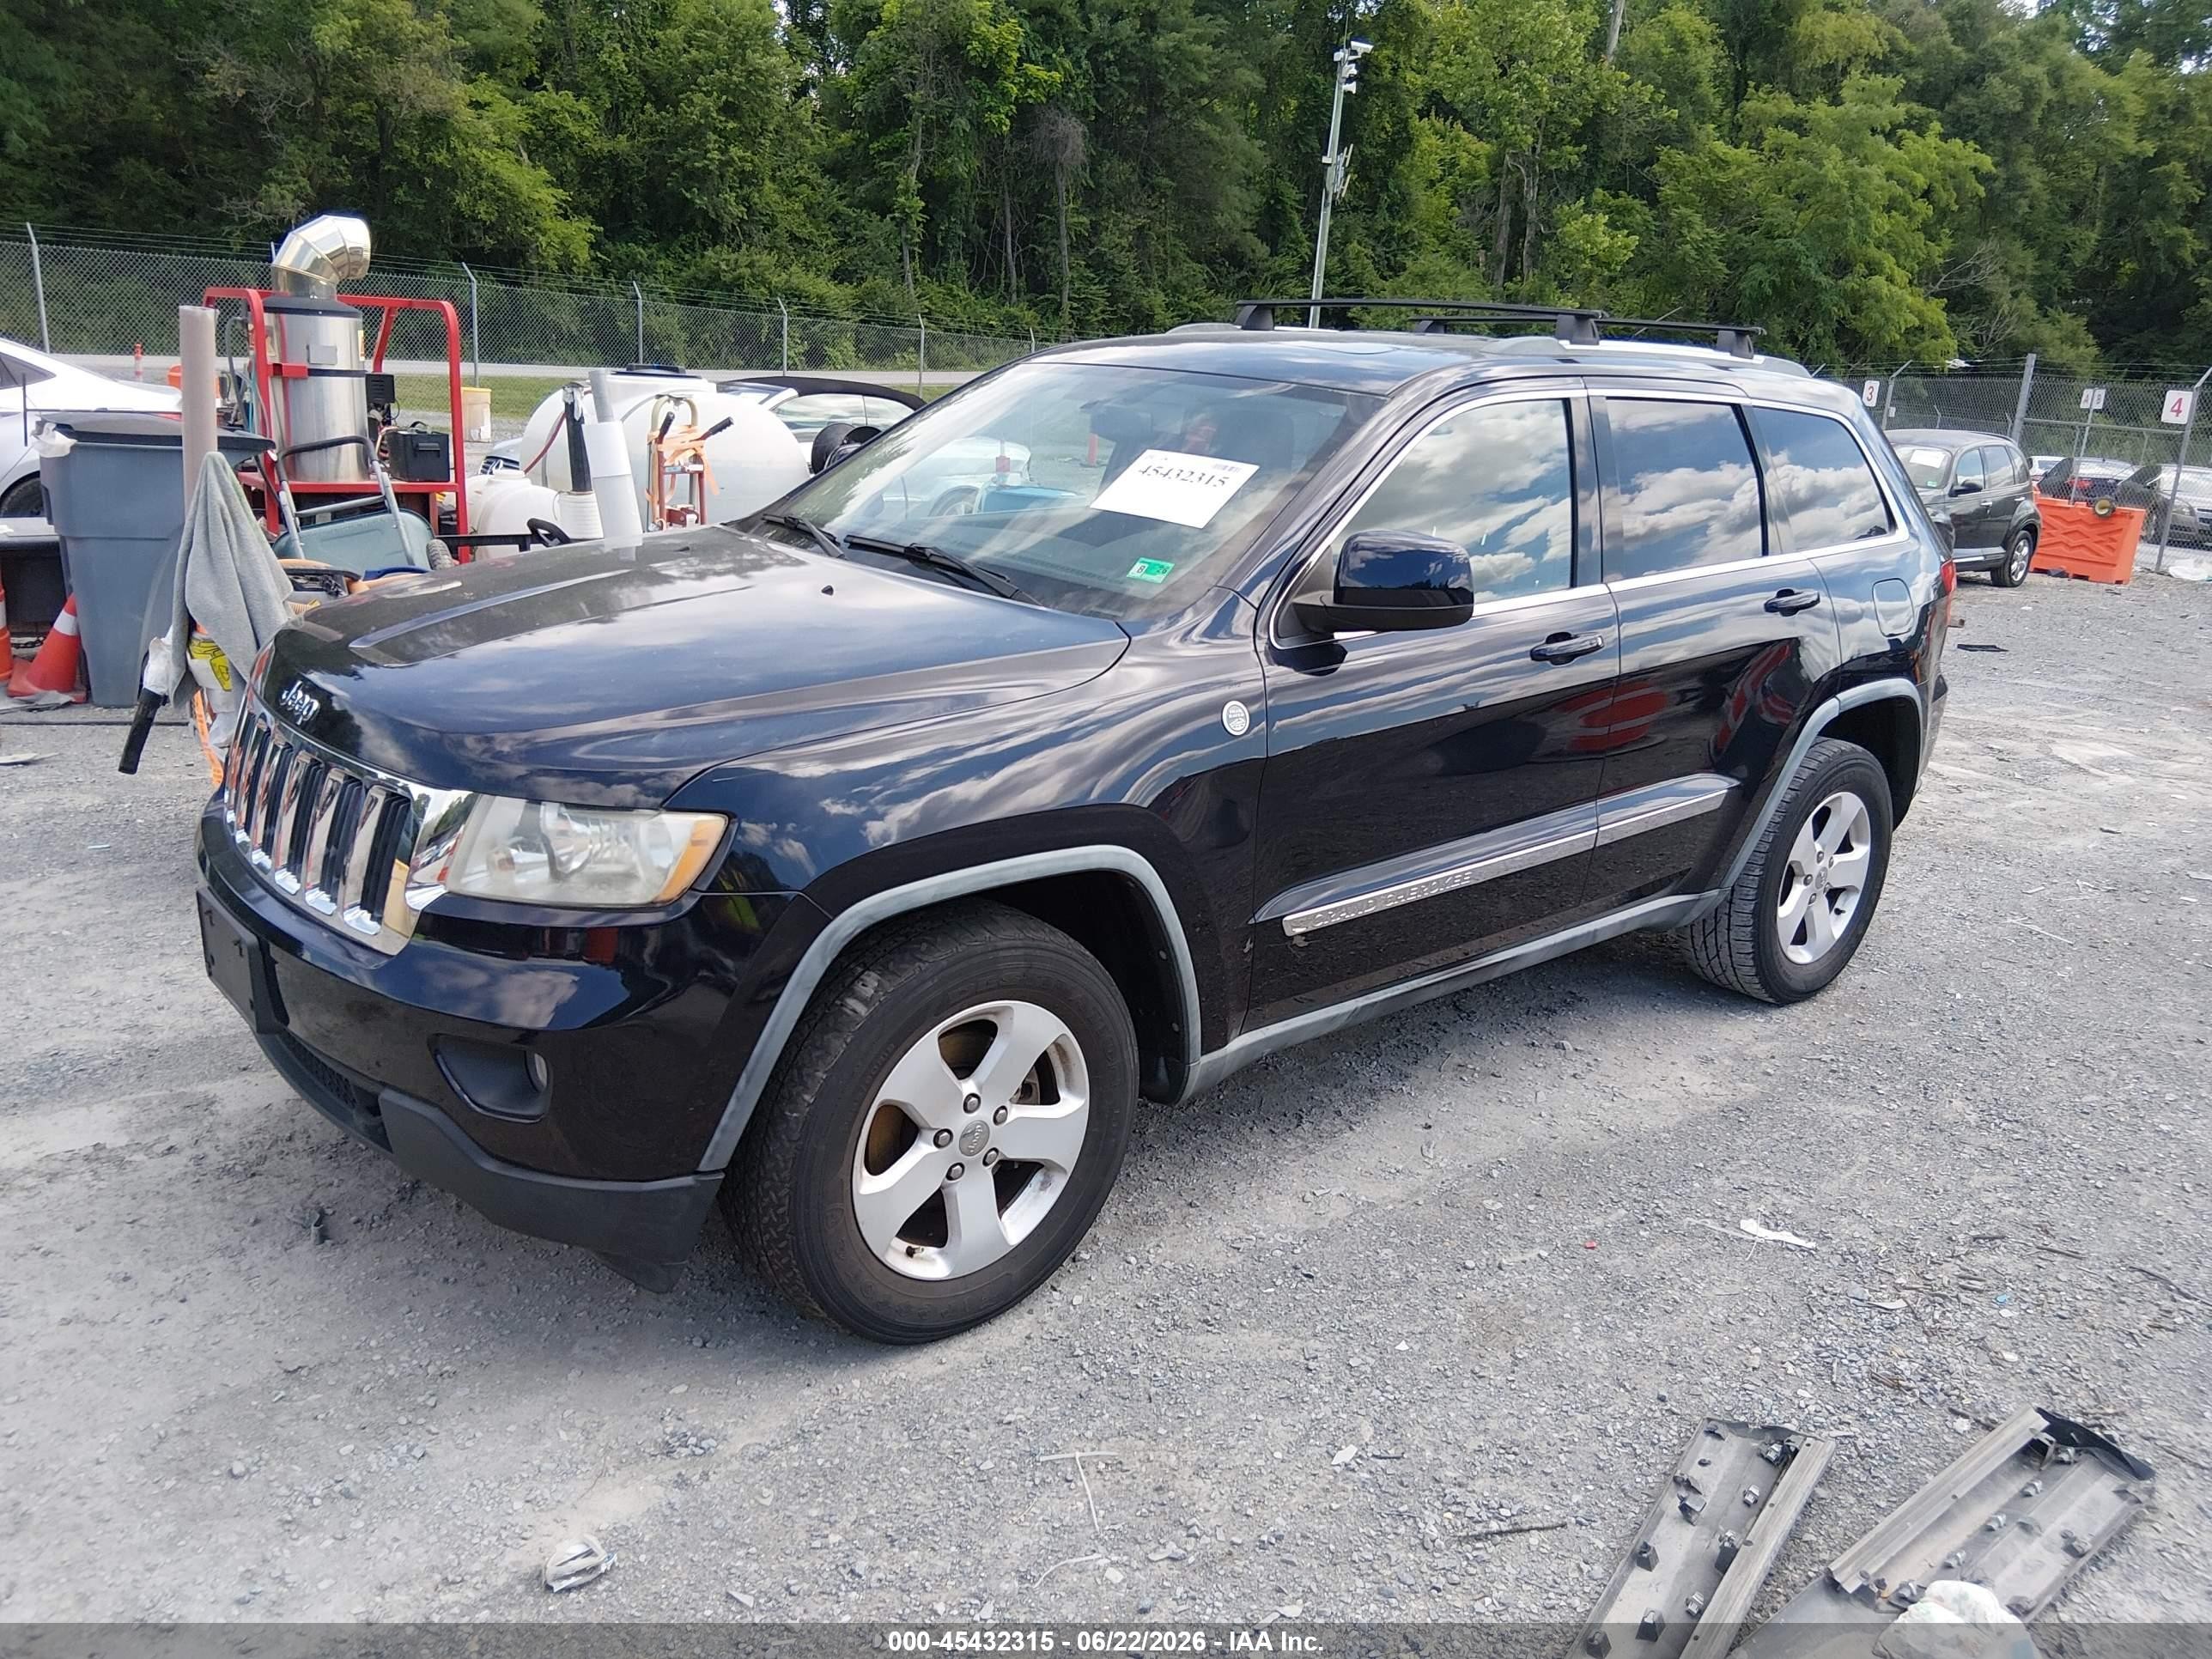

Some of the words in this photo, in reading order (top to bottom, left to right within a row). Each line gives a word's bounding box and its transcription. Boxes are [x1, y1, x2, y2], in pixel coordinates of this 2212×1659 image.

[1866, 386, 1875, 402] 3
[2169, 397, 2184, 417] 4
[1139, 465, 1230, 487] 45432315
[279, 680, 320, 726] Jeep
[1314, 899, 1376, 927] GRAND
[1386, 872, 1472, 907] CHEROKEE
